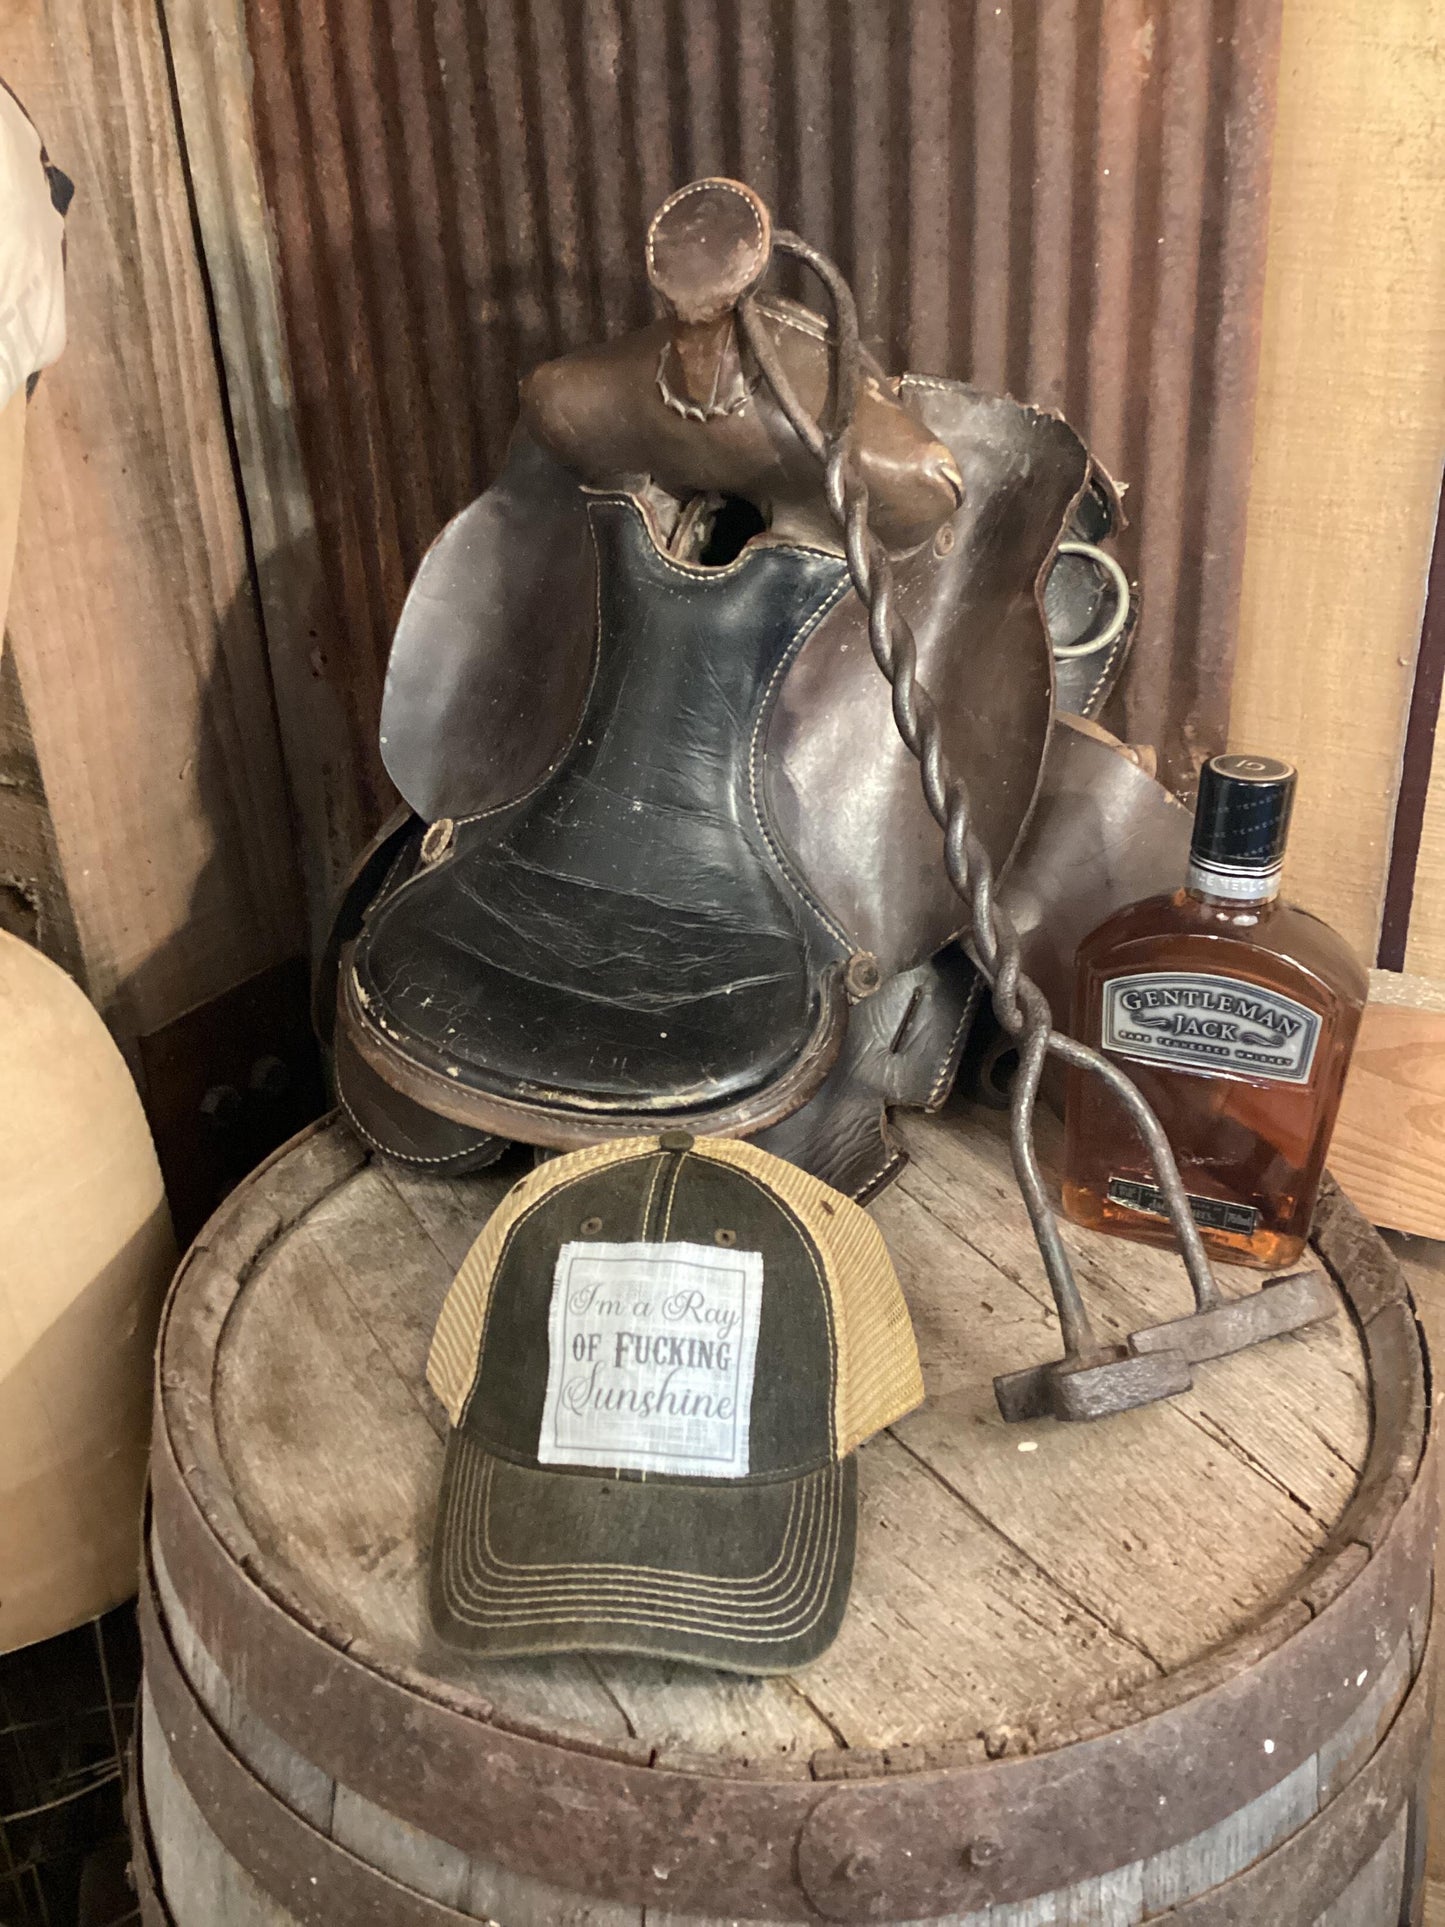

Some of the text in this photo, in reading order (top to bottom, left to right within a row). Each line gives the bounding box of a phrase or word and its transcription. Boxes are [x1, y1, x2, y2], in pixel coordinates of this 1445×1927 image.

[1121, 990, 1301, 1039] GENTLEMAN
[1172, 1014, 1238, 1042] JACK
[1119, 1030, 1294, 1067] RARE TENNESSEE WHISKEY
[632, 1300, 655, 1316] a
[661, 1289, 741, 1340] Ray
[572, 1331, 733, 1372] OF FUCKING
[561, 1360, 737, 1421] Sunshine
